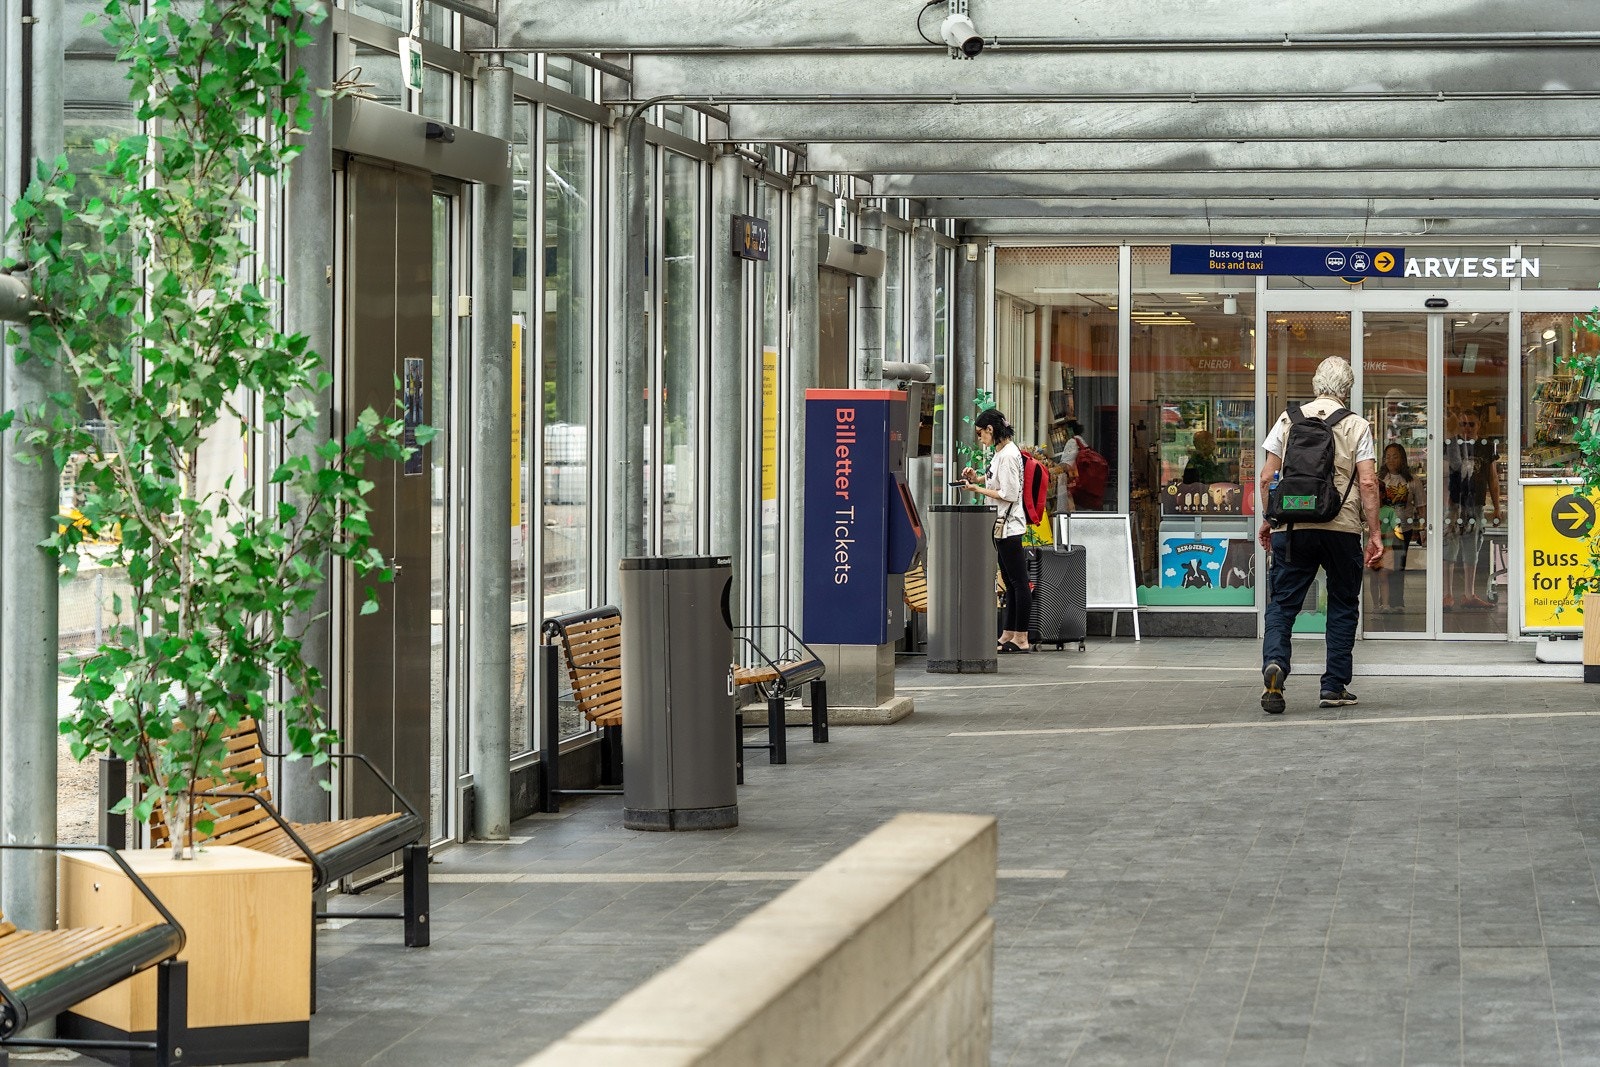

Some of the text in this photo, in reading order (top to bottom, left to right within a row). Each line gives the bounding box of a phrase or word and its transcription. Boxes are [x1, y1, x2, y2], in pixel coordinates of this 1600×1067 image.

[1209, 249, 1263, 261] Buss og taxi
[1209, 260, 1264, 270] Bus and taxi
[1198, 360, 1232, 369] ENERGI
[835, 408, 856, 585] Billetter Tickets
[1533, 549, 1579, 567] Buss
[1532, 572, 1562, 590] for
[1533, 598, 1548, 606] Rail
